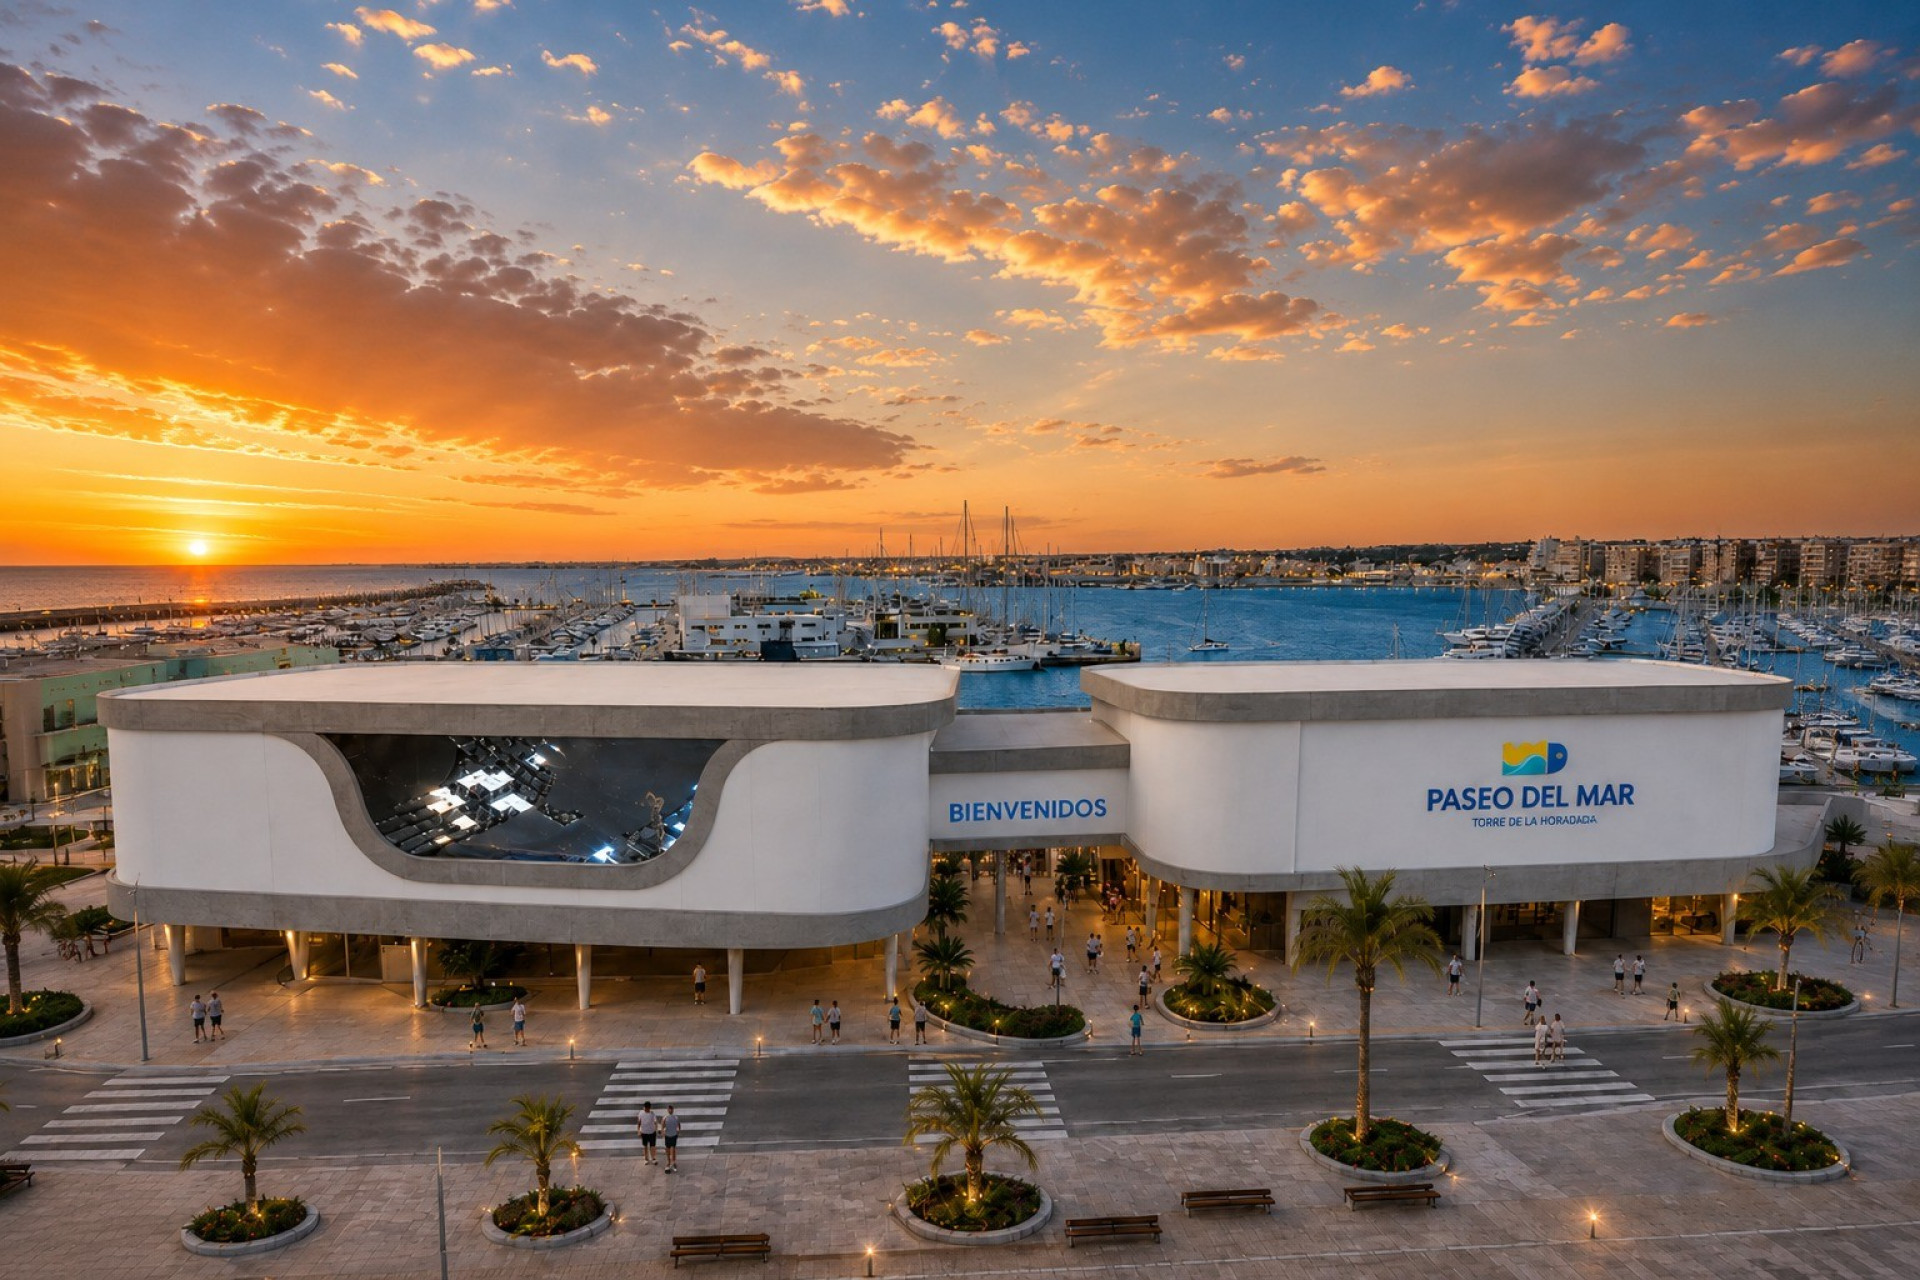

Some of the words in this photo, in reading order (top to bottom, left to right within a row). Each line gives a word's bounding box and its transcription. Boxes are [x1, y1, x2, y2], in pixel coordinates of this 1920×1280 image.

[1427, 786, 1514, 812] PASEO
[1521, 785, 1569, 808] DEL
[1576, 784, 1635, 807] MAR
[949, 799, 1107, 823] BIENVENIDOS
[1472, 817, 1506, 828] TORRE
[1509, 816, 1522, 827] DE
[1524, 816, 1538, 827] LA
